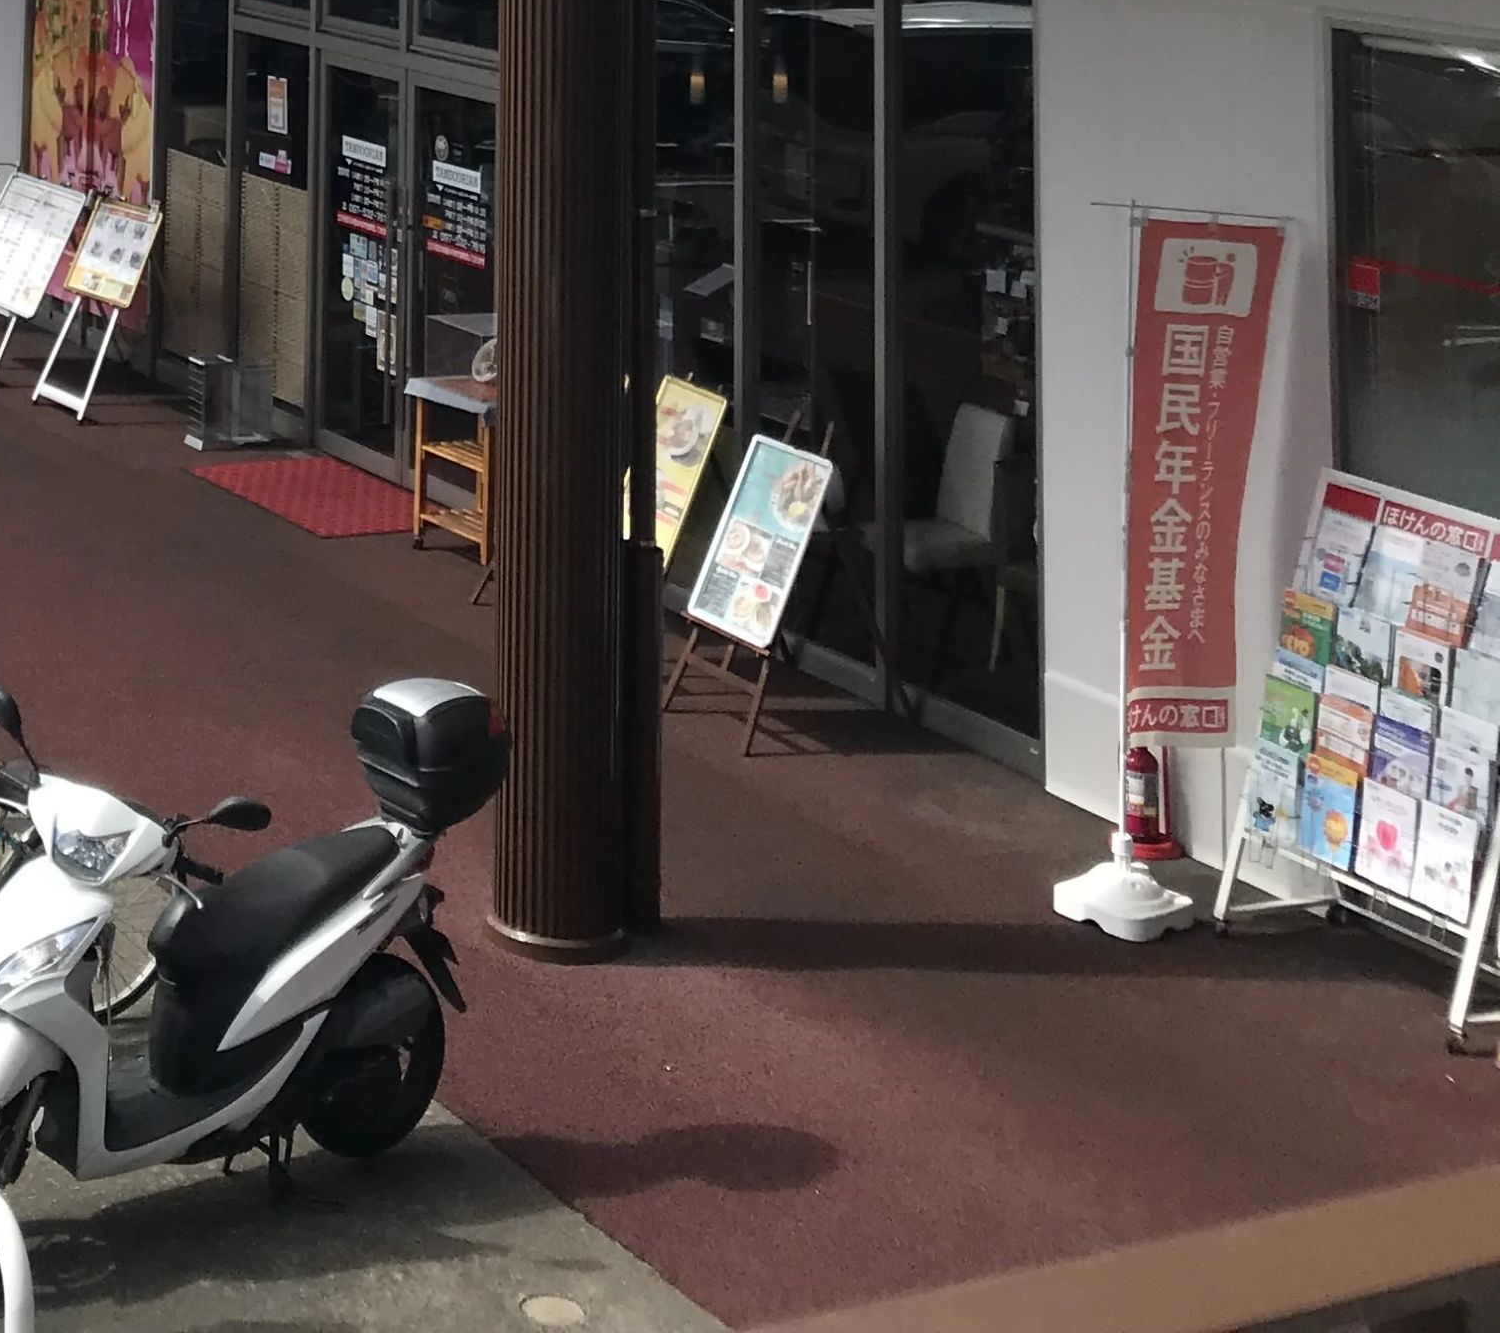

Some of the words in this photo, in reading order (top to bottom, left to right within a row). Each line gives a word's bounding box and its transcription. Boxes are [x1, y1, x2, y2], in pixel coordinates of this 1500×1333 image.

[1138, 323, 1210, 673] 国民年金基金
[1383, 505, 1485, 550] ほけんの窓口
